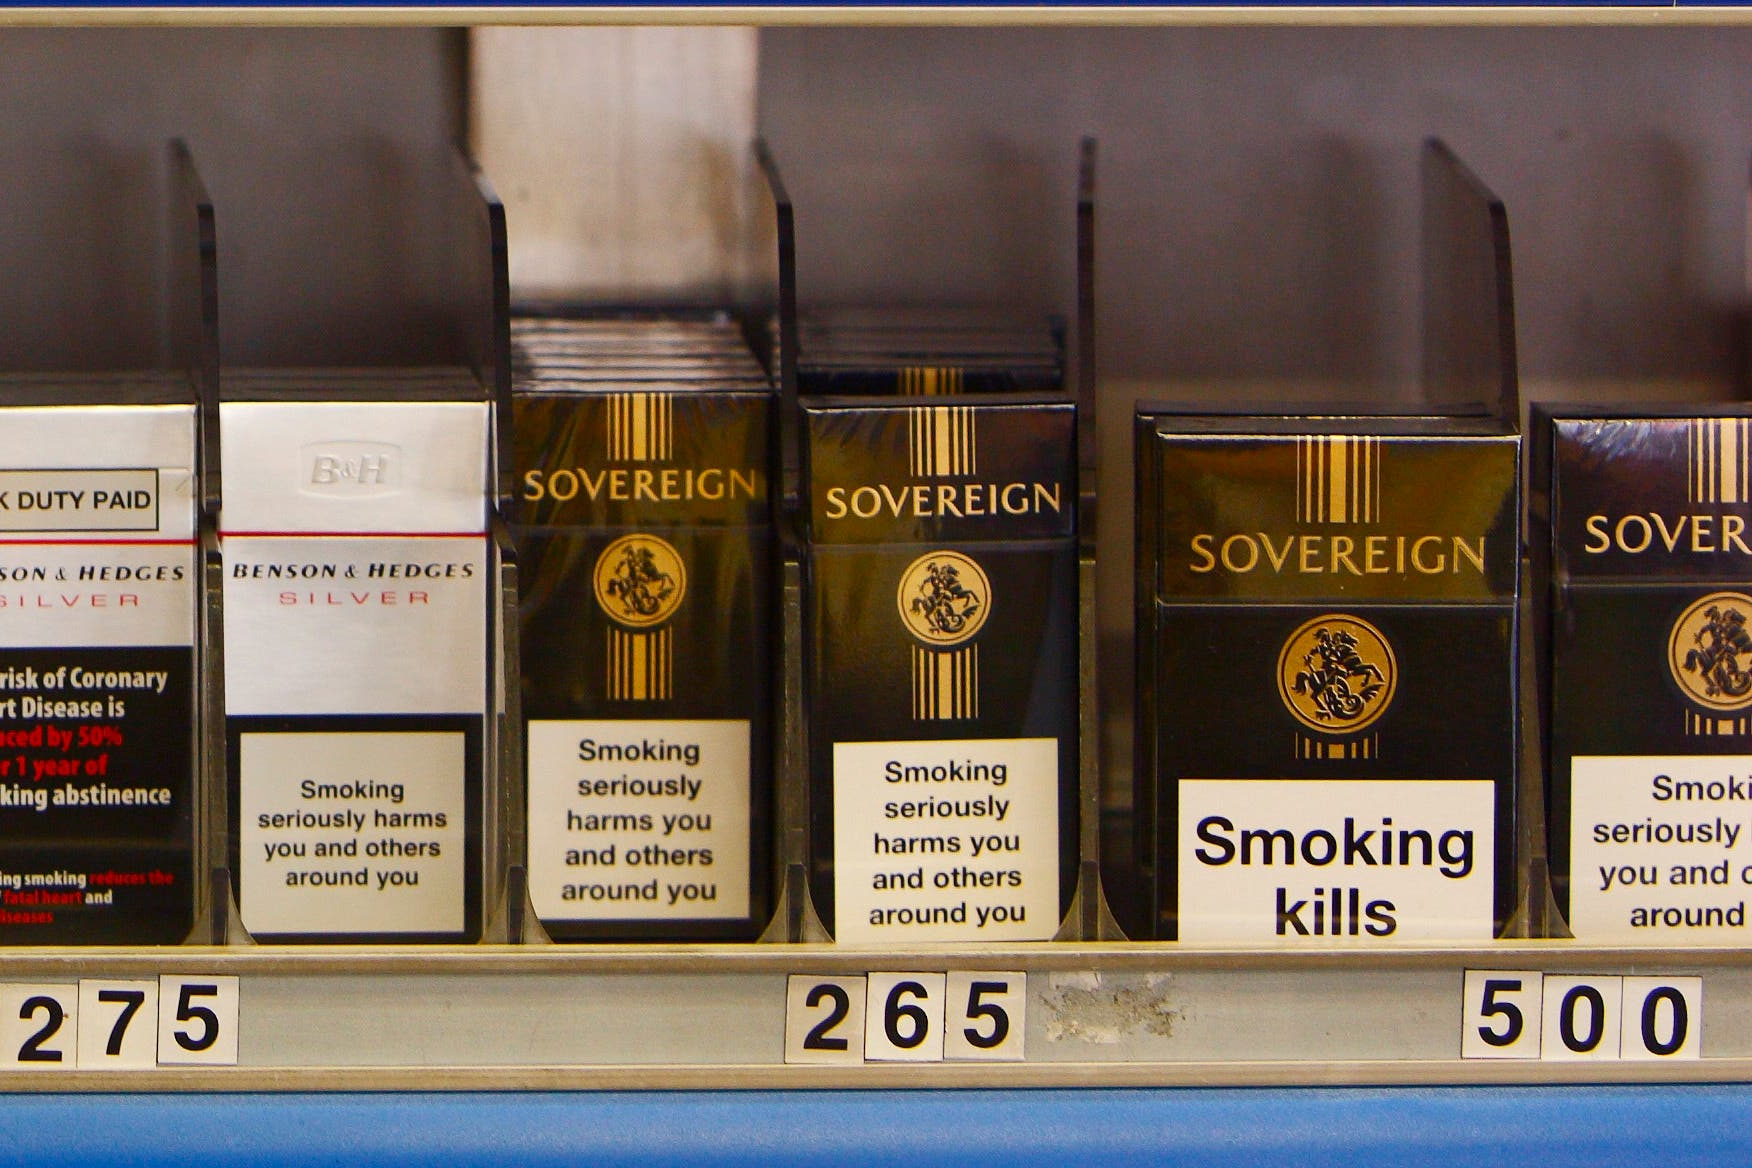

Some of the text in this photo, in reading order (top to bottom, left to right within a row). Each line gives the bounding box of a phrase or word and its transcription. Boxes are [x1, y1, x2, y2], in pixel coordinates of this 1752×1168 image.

[524, 468, 758, 502] SOVEREIGN
[18, 491, 84, 510] DUTY
[93, 490, 151, 509] PAID
[825, 482, 1062, 519] SOVEREIGN
[1585, 512, 1752, 555] SOVER
[1190, 533, 1486, 576] SOVEREIGN
[55, 568, 68, 581] &
[79, 565, 185, 581] HEDGES
[233, 562, 475, 580] BENSON & HEDGES
[279, 591, 429, 606] SILVER
[43, 666, 66, 689] of
[70, 666, 168, 693] Coronary
[22, 696, 102, 718] Disease
[108, 696, 125, 717] is
[48, 725, 73, 751] by
[78, 725, 123, 747] 50%
[578, 738, 701, 767] Smoking
[16, 755, 26, 776] 1
[34, 759, 80, 781] year
[85, 753, 108, 775] of
[884, 759, 1008, 786] Smoking
[52, 783, 171, 805] abstinence
[300, 779, 405, 804] Smoking
[577, 774, 702, 802] seriously
[258, 808, 448, 831] seriously harms
[884, 795, 1010, 821] seriously
[566, 810, 712, 837] harms you
[1593, 817, 1741, 849] seriously
[264, 837, 441, 861] you and others
[564, 844, 713, 866] and others
[873, 833, 1021, 858] harms you
[1194, 815, 1475, 879] Smoking
[24, 870, 87, 889] smoking
[285, 866, 419, 891] around you
[872, 867, 1022, 890] and others
[85, 889, 113, 905] and
[561, 878, 717, 906] around you
[869, 903, 1026, 928] around you
[1275, 887, 1398, 937] kills
[17, 984, 219, 1062] 275
[804, 981, 1009, 1050] 265
[1477, 979, 1685, 1056] 500
